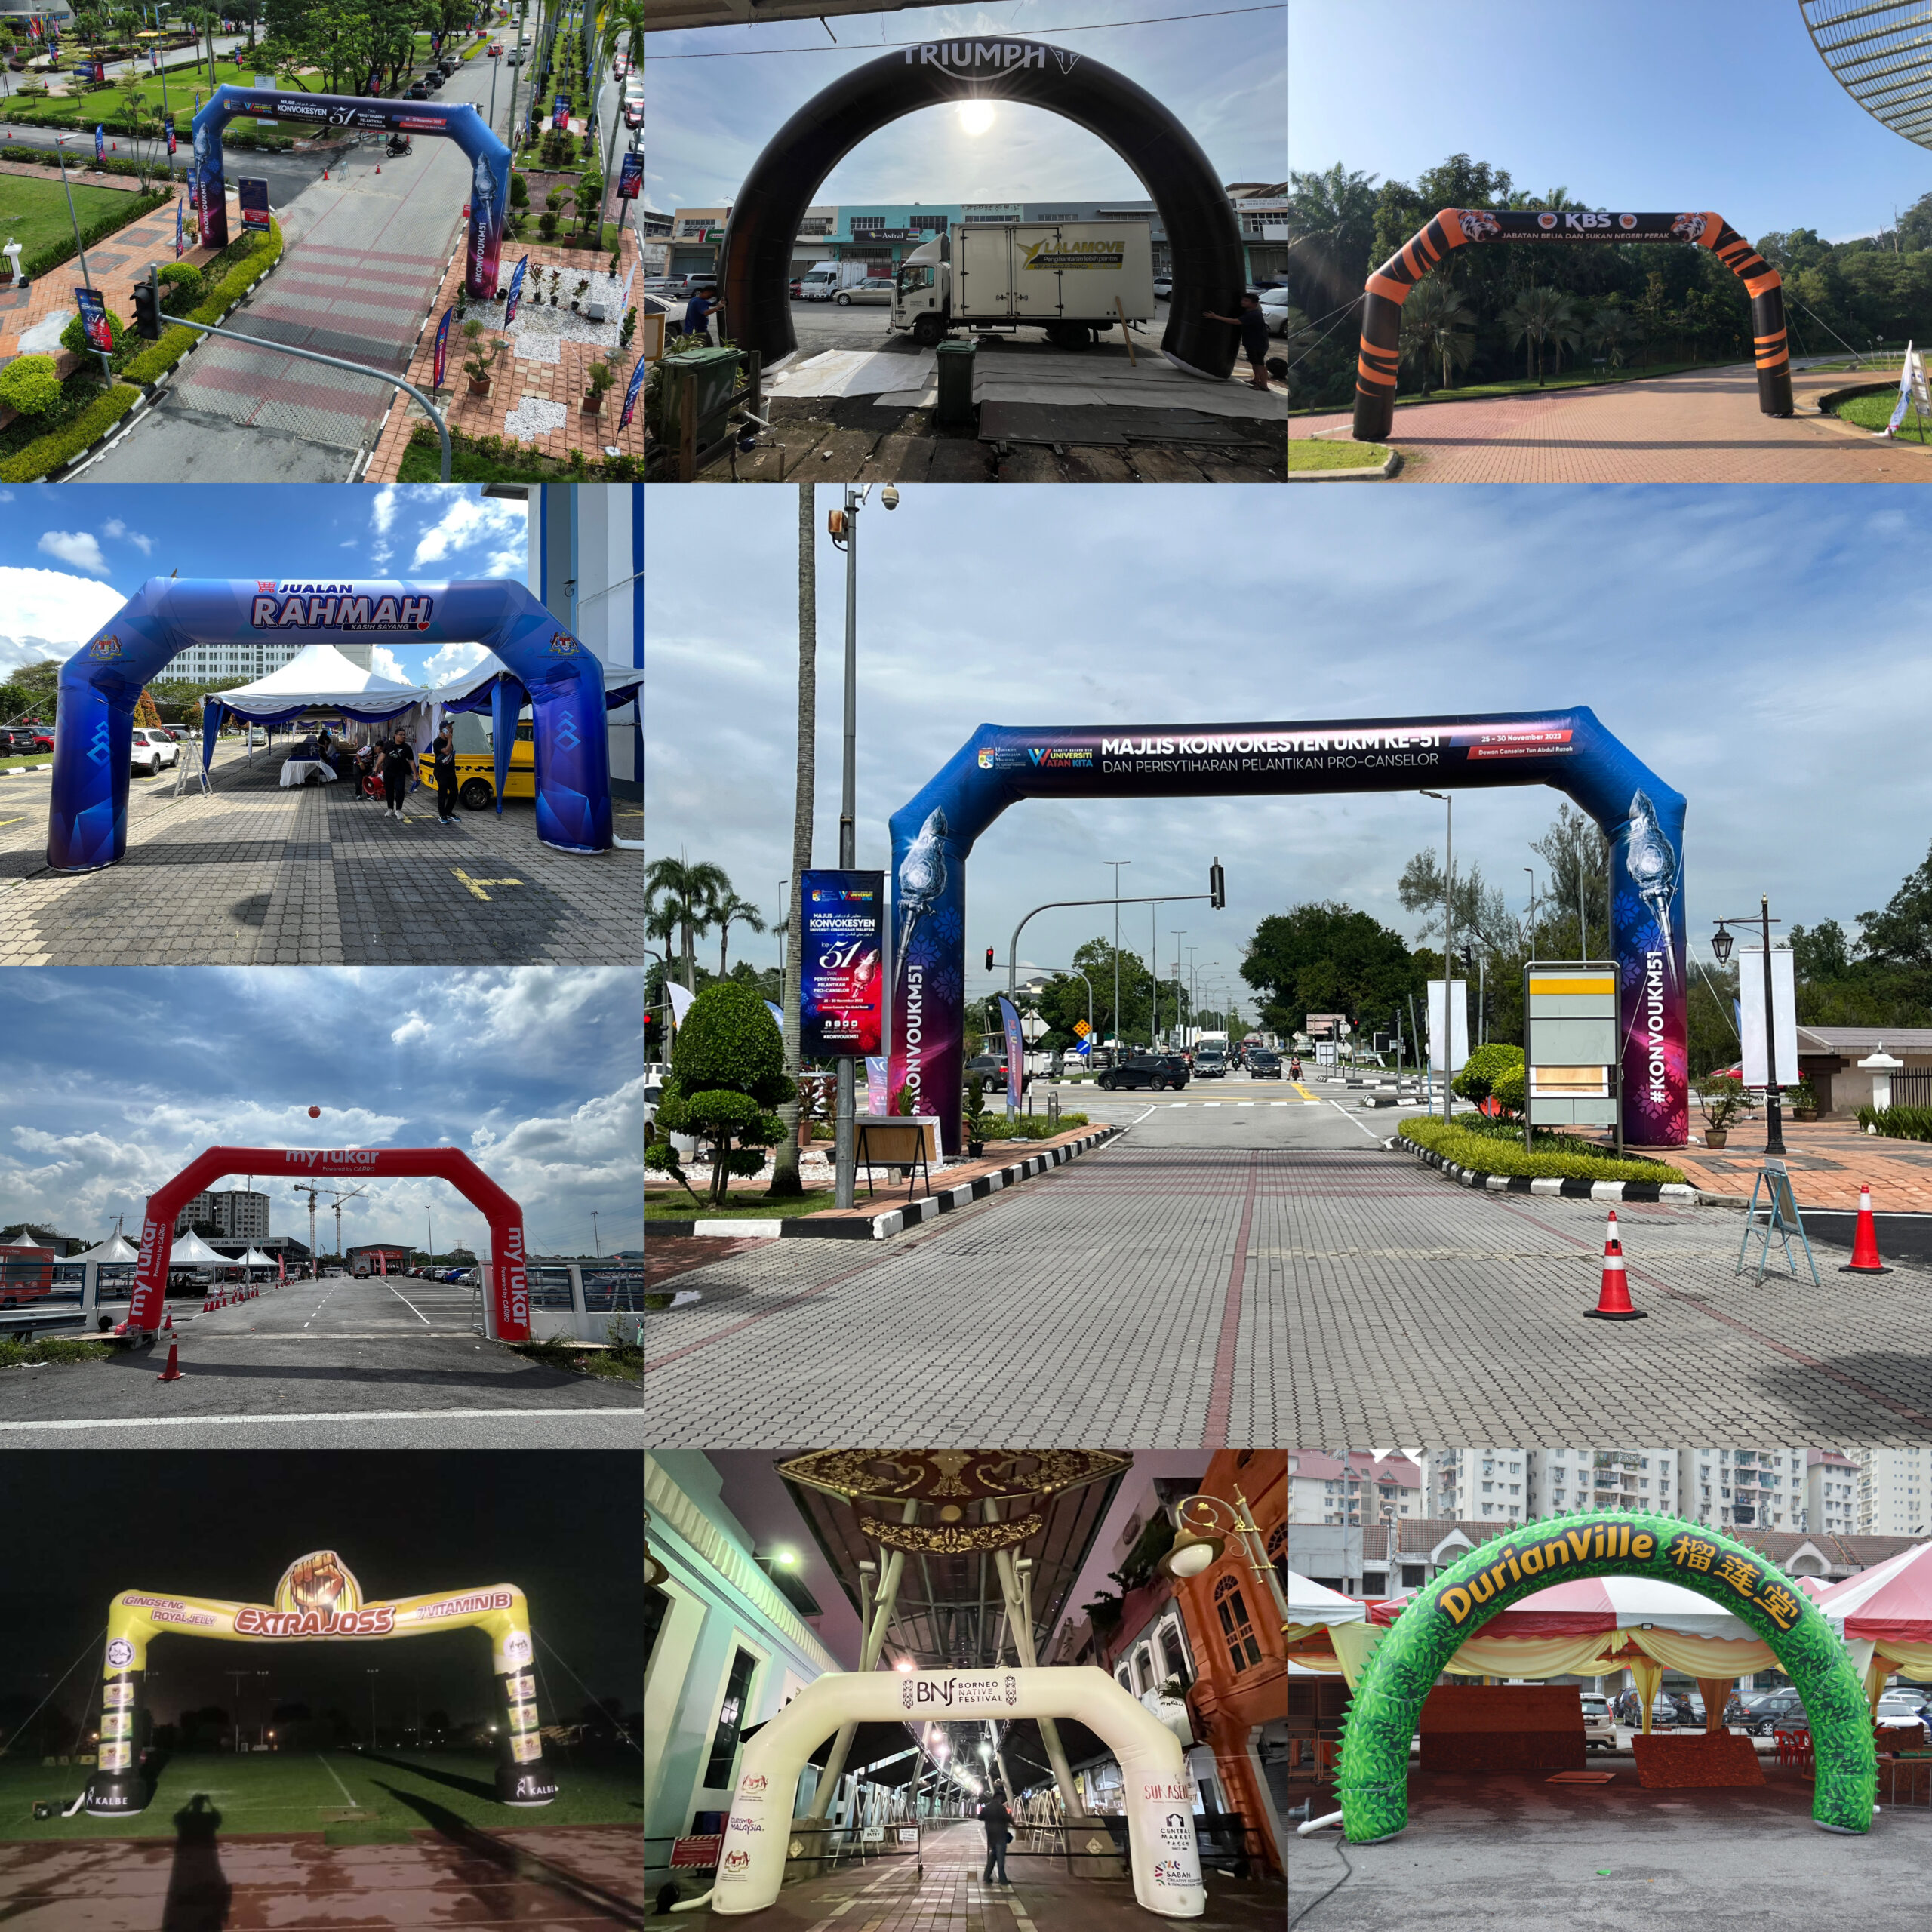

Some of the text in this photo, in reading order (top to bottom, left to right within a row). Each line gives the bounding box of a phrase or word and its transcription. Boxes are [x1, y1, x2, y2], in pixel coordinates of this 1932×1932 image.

[900, 42, 1045, 81] TRIUMPH
[277, 104, 327, 116] KONVOKESYEN
[329, 106, 357, 125] 51
[200, 181, 210, 235] #KONVOUKM51
[1565, 213, 1611, 232] KBS
[475, 222, 486, 283] #KONVOUKM51
[1044, 240, 1125, 253] LALAMOVE
[278, 583, 352, 594] JUALAN
[251, 596, 432, 627] RAHMAH
[1102, 731, 1440, 755] MAJLIS KONVOKESYEN UKM KE-51
[1507, 734, 1543, 742] November
[1051, 752, 1093, 760] UNIVERSITI
[1072, 759, 1093, 768] KITA
[1103, 753, 1438, 773] DAN PERISYTIHARAN PELANTIKAN PRO-CANSELOR
[810, 919, 875, 928] KONVOKESYEN
[819, 940, 862, 968] 51
[1647, 951, 1666, 1103] #KONVOUKM51
[286, 1149, 379, 1168] myTukar
[153, 1253, 162, 1277] Powered
[158, 1223, 166, 1244] CARRO
[131, 1218, 157, 1316] myTukar
[504, 1227, 528, 1327] myTukar
[502, 1291, 507, 1299] by
[1439, 1524, 1654, 1626] DurianVille
[1670, 1536, 1799, 1631] 榴莲堂
[124, 1596, 185, 1610] GINGSENG
[417, 1594, 512, 1620] 7 VITAMIN B
[153, 1611, 215, 1625] ROYAL JELLY
[235, 1607, 395, 1635] EXTRA JOSS
[530, 1785, 554, 1795] KALBE
[95, 1797, 128, 1805] KALBE
[730, 1823, 761, 1835] MALAYSIA
